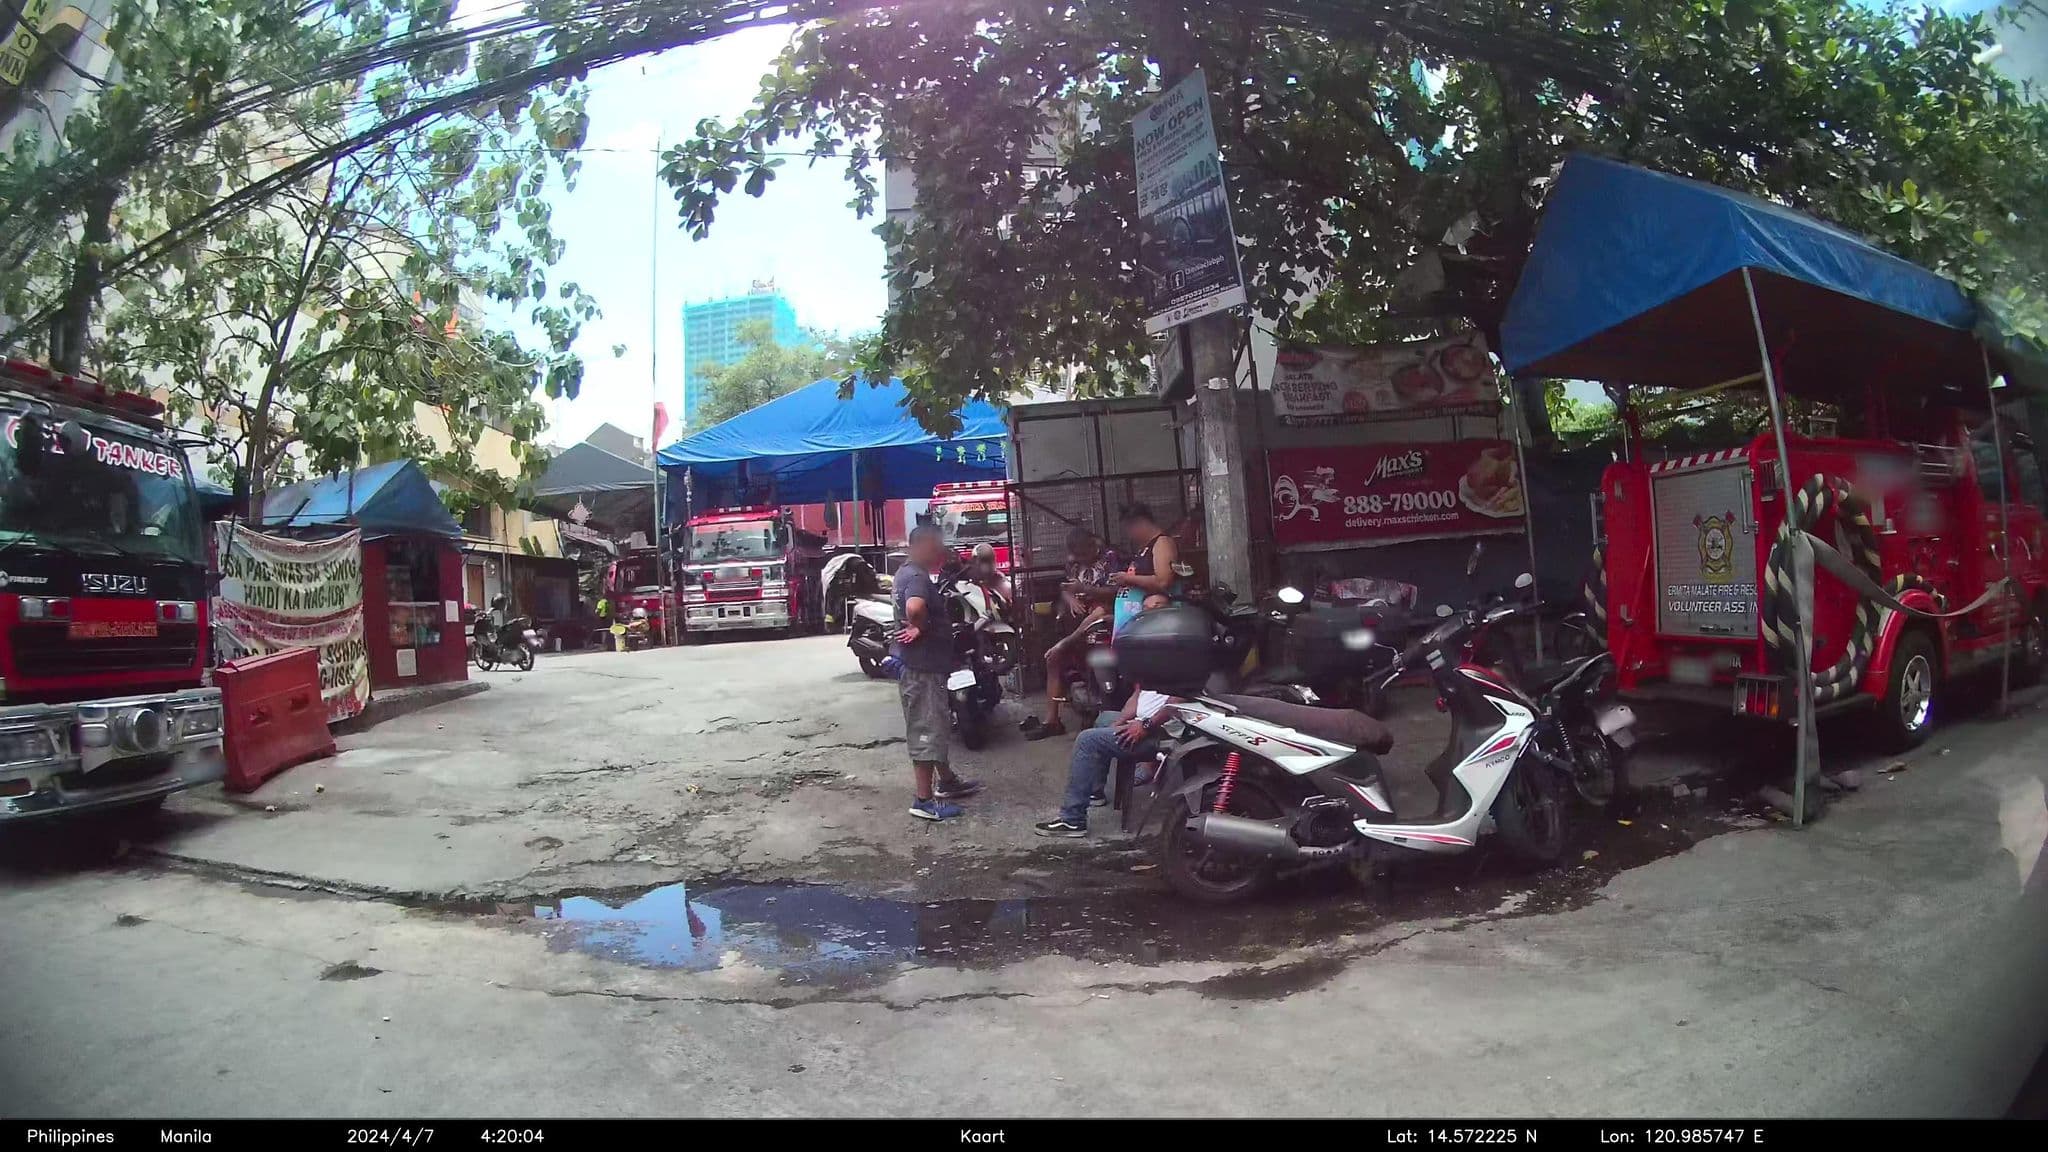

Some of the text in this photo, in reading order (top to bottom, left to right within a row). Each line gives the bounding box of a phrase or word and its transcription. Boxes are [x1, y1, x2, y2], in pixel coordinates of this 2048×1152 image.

[1136, 96, 1203, 155] NOW OPEN
[92, 437, 183, 480] TANKER
[1364, 450, 1423, 486] Max's
[1343, 490, 1457, 514] 888-79000
[1345, 512, 1459, 527] delivery.maxschicken.com
[81, 573, 147, 594] ISUZU
[1668, 584, 1691, 596] ERMITA
[1691, 584, 1717, 596] MALATE
[1718, 584, 1733, 596] FIRE
[244, 584, 279, 609] HINDI
[283, 588, 300, 609] KA
[1668, 601, 1722, 612] VOLUNTEER
[1723, 601, 1747, 613] ASS.
